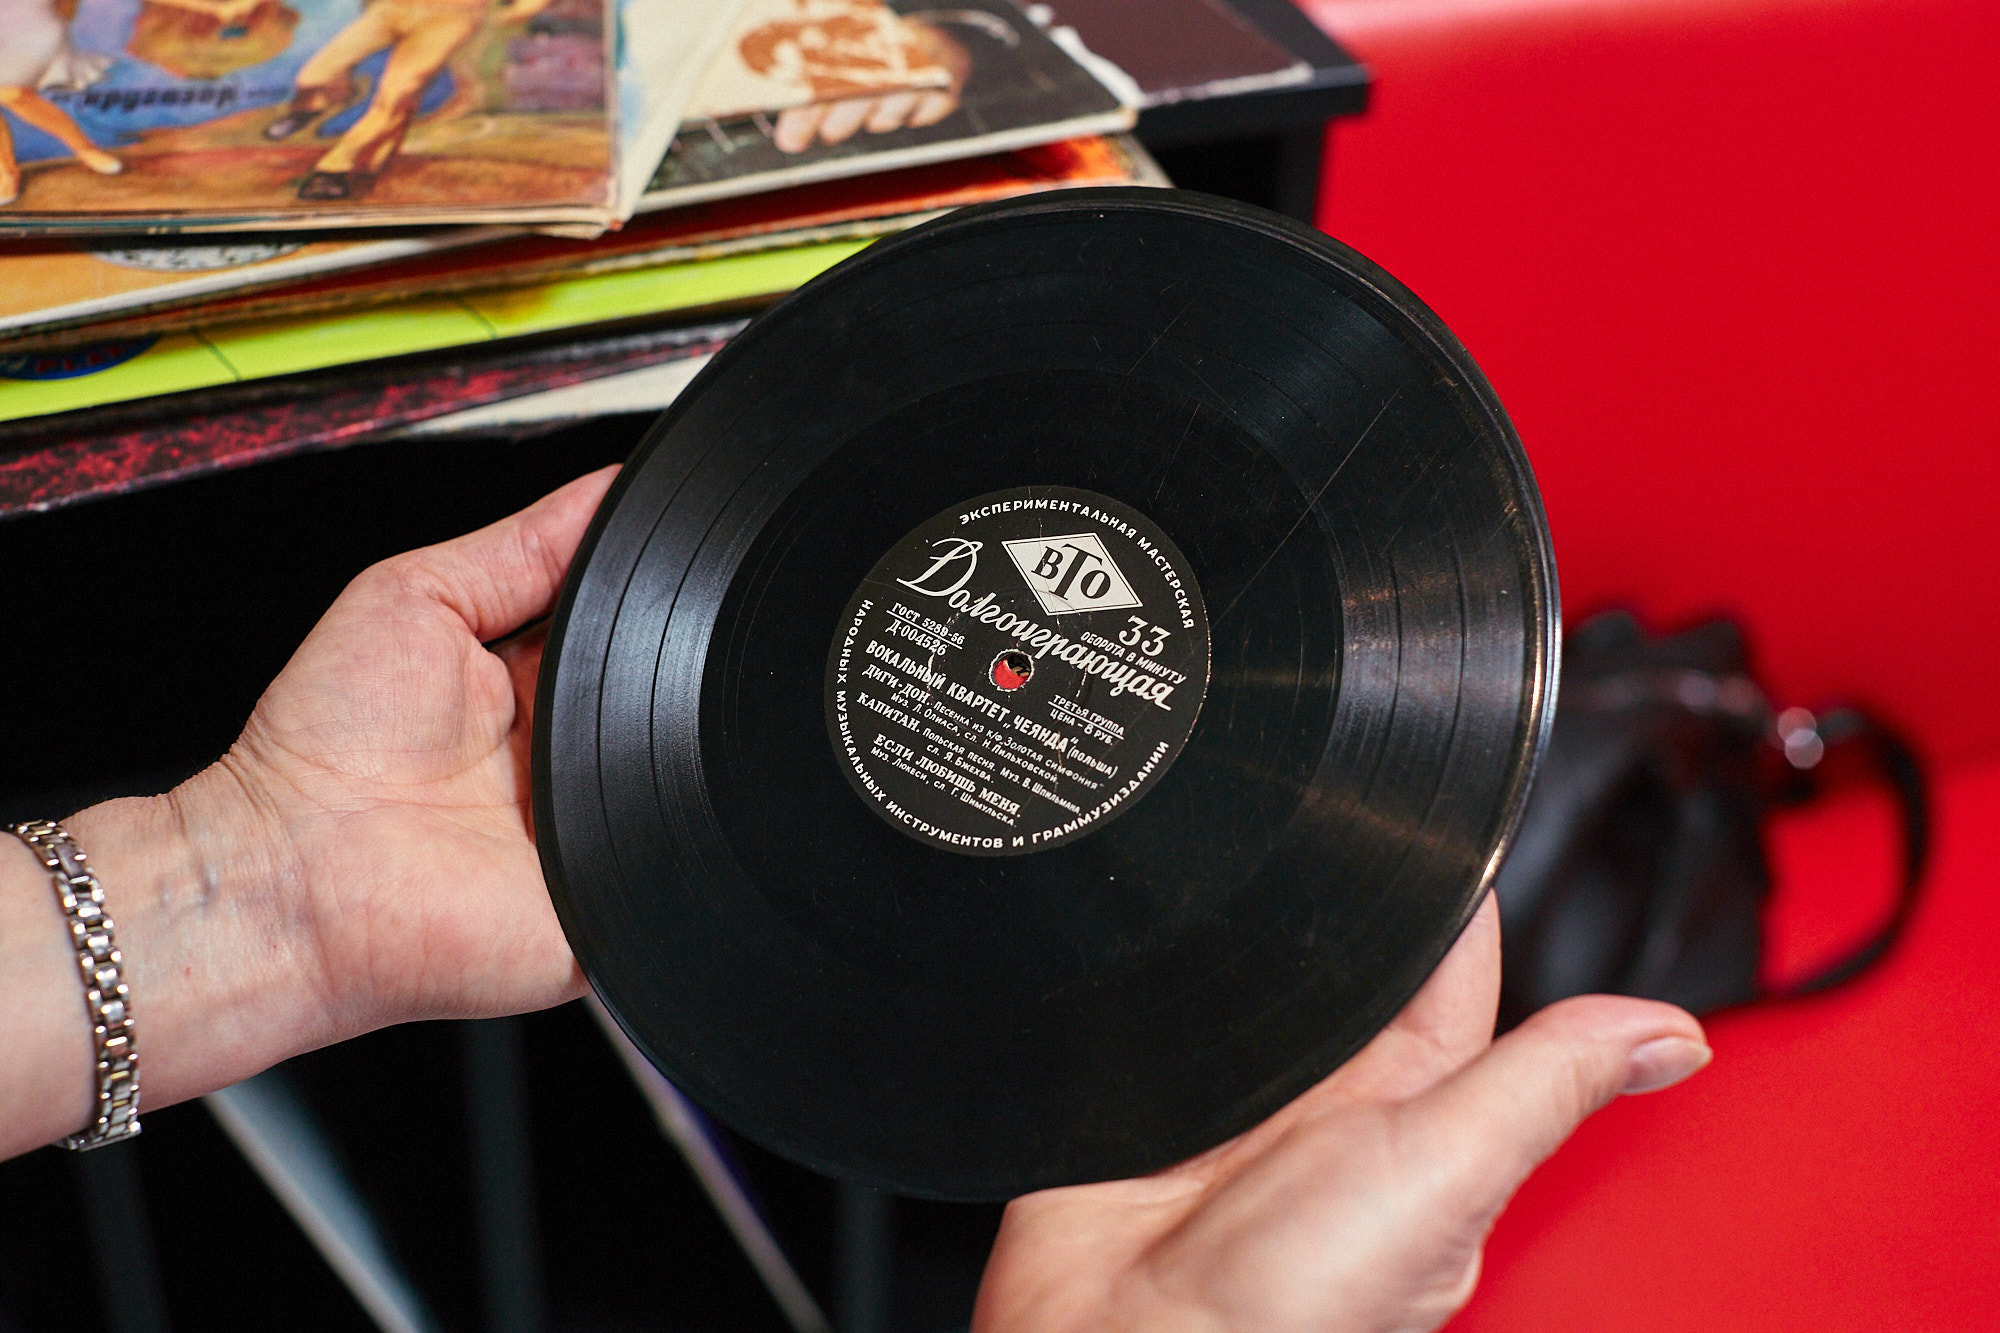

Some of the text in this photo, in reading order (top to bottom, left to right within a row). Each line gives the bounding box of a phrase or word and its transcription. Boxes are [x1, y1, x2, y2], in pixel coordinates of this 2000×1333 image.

[959, 499, 1195, 629] ЭКСПЕРИМЕНТАЛЬНАЯ МАСТЕРСКАЯ
[1031, 543, 1111, 601] ВТО
[837, 599, 874, 684] НАРОДНЫХ
[891, 602, 965, 645] ГОСТ 5289-56
[896, 537, 1175, 711] Долгоиграющая
[1118, 615, 1171, 656] 33
[865, 639, 947, 690] ВОКАЛЬНЫЙ
[946, 682, 1011, 722] КВАРТЕТ
[1080, 631, 1187, 685] ОБОРОТА В МИНУТУ
[912, 704, 922, 715] Л.
[1049, 708, 1075, 727] ЦЕНА
[1083, 723, 1093, 735] 8
[1093, 730, 1114, 746] РУБ.
[1053, 694, 1125, 736] ТРЕТЬЯ ГРУППА
[836, 690, 887, 802] МУЗЫКАЛЬНЫХ
[856, 692, 920, 732] КАПИТАН.
[1022, 776, 1031, 790] В.
[943, 751, 953, 764] Я.
[873, 733, 1021, 818] ЕСЛИ ЛЮБИШЬ МЕНЯ.
[950, 787, 958, 798] Г.
[885, 801, 1004, 849] ИНСТРУМЕНТОВ
[1012, 835, 1025, 848] И
